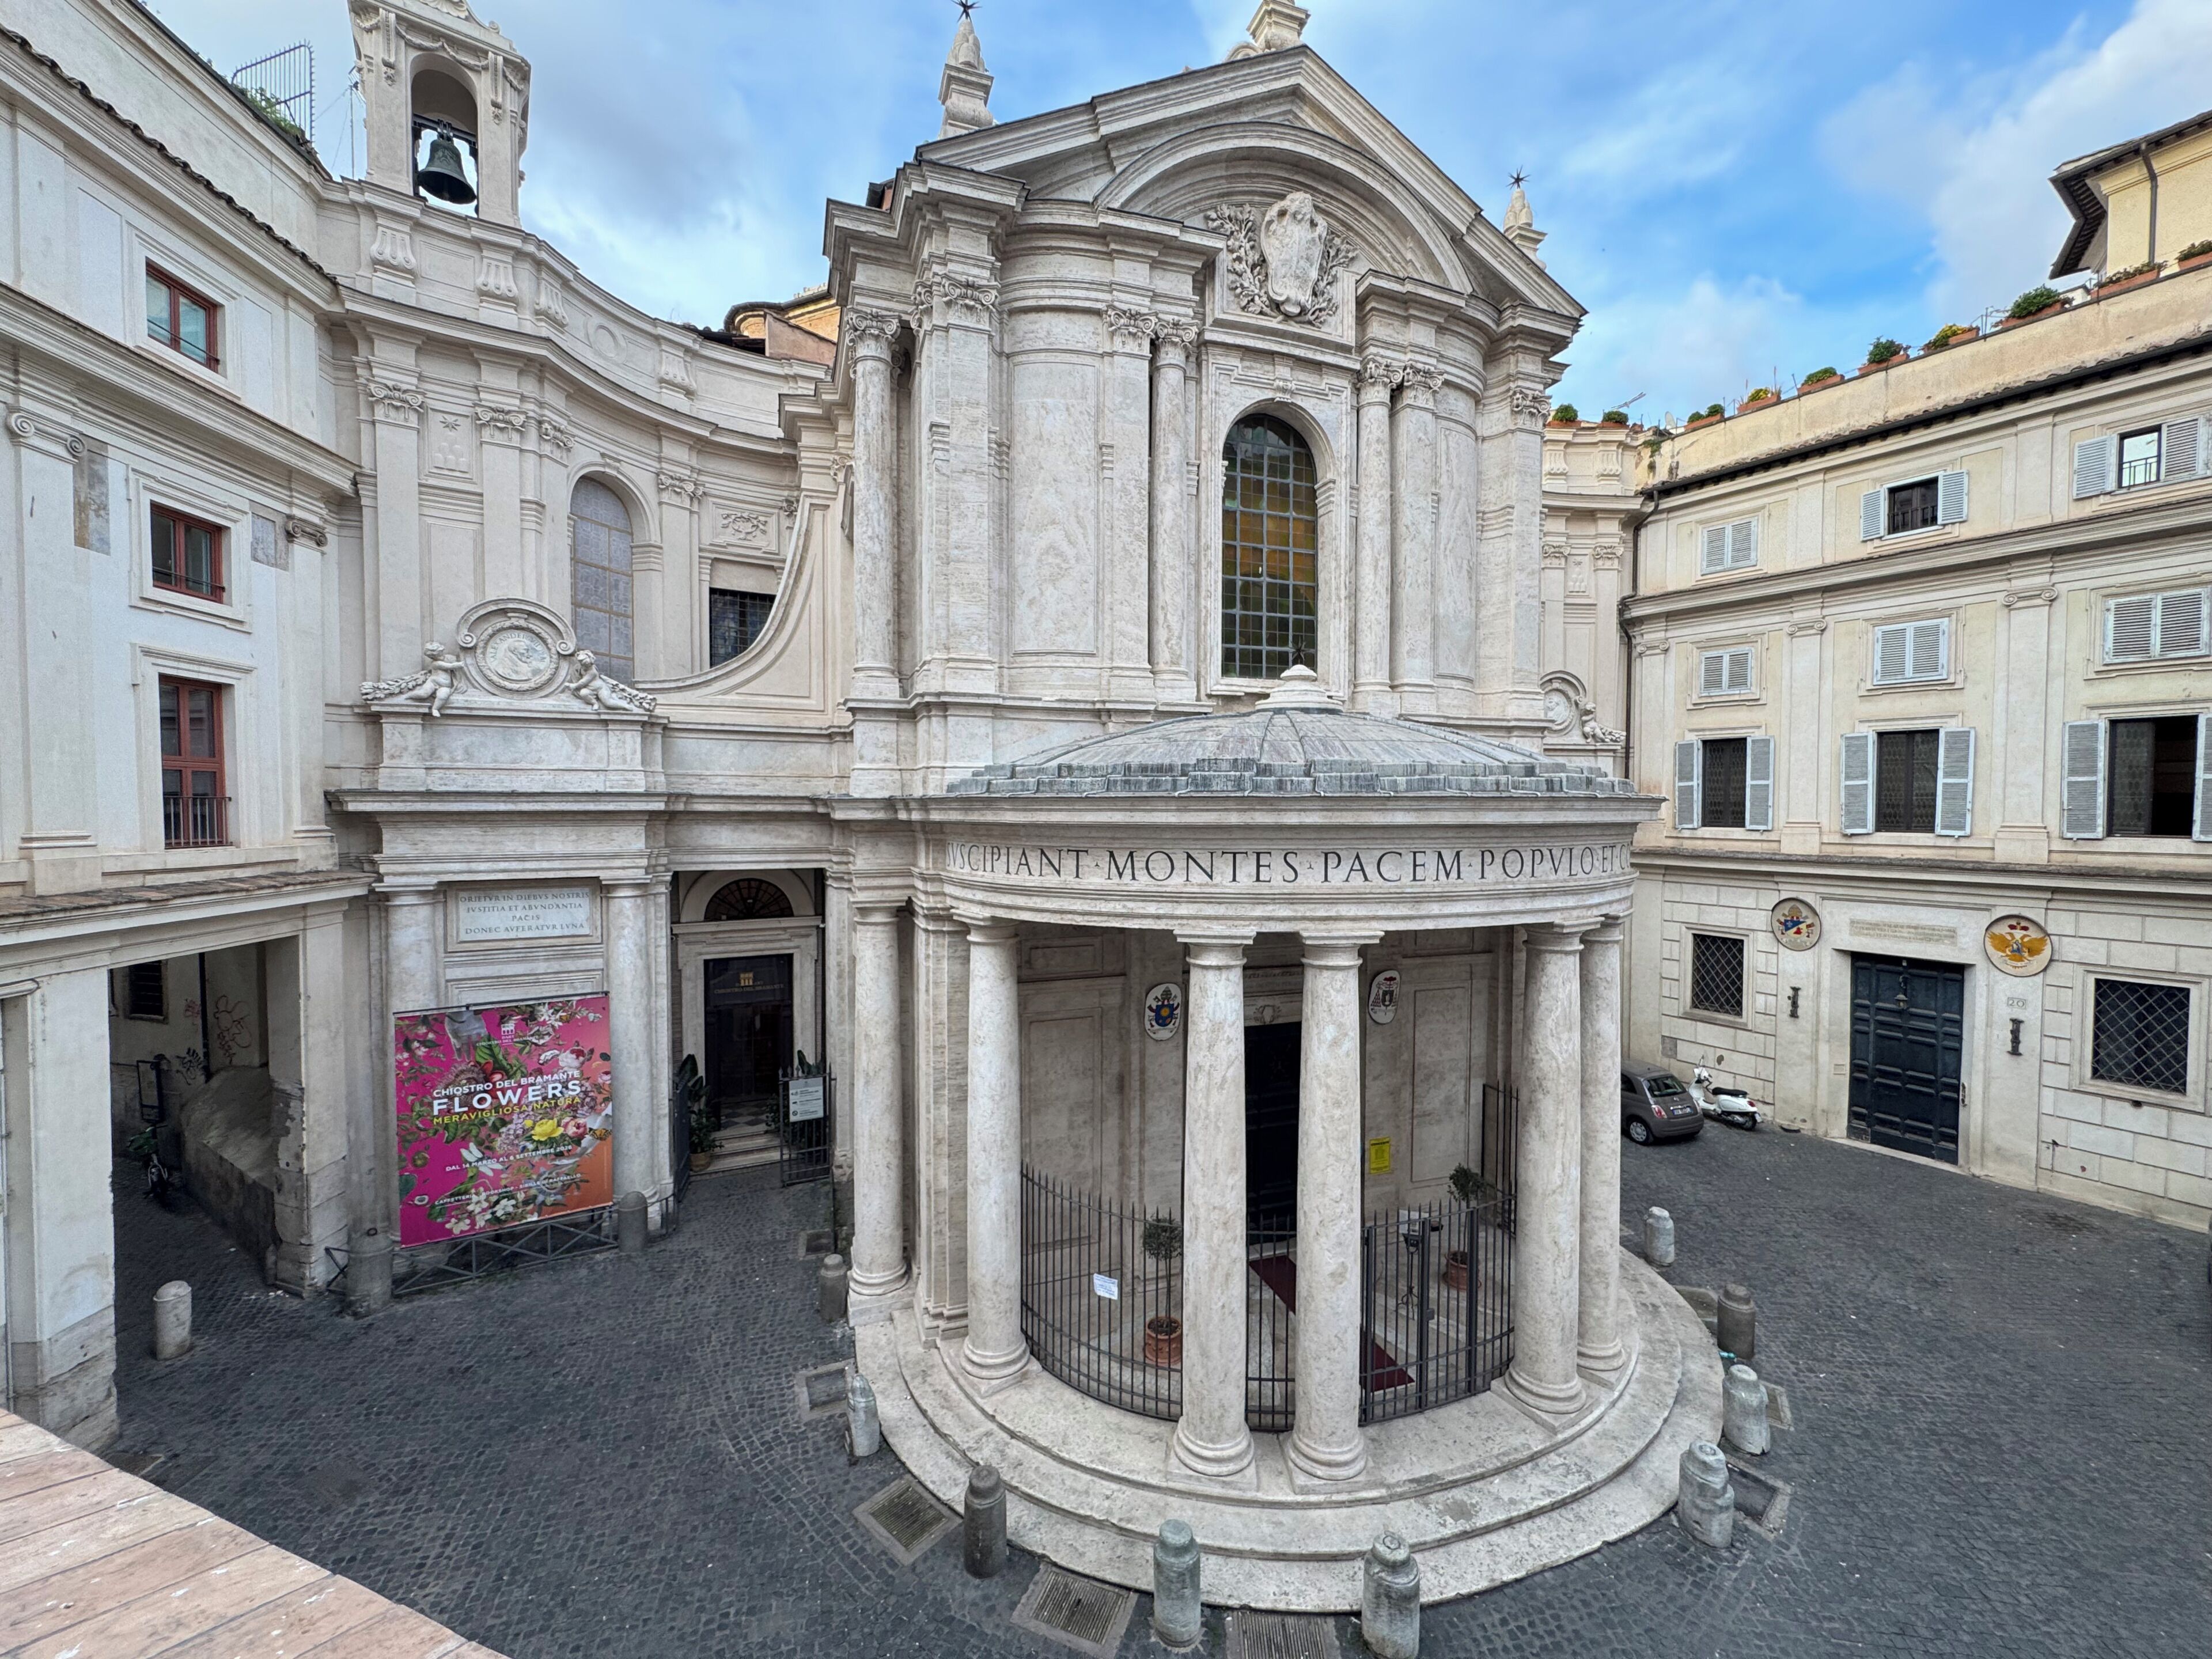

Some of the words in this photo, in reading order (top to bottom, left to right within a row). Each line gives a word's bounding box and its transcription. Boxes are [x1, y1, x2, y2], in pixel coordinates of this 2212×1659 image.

[946, 842, 1088, 879] SVSCIPIANT
[1104, 849, 1300, 883] MONTES
[1320, 849, 1464, 883] PACEM
[1478, 846, 1594, 880] POPVLO
[1601, 845, 1616, 873] ET
[460, 895, 501, 903] ORIETVR
[516, 893, 549, 901] DIEBVS
[551, 892, 589, 900] NOSTRIS
[522, 903, 583, 911] ABVNDANTIA
[465, 926, 501, 934] DONEC
[503, 923, 559, 933] AVFERATVR
[2009, 999, 2025, 1007] 20
[433, 1082, 493, 1097] CHIOSTRO
[496, 1080, 518, 1089] DEL
[520, 1070, 581, 1086] BRAMANTE
[433, 1080, 582, 1116] FLOWERS
[433, 1104, 528, 1125] MERAVIGLIOSA
[533, 1096, 581, 1111] NATURA
[472, 1158, 497, 1166] MARZO
[516, 1147, 555, 1159] SETTEMBRE
